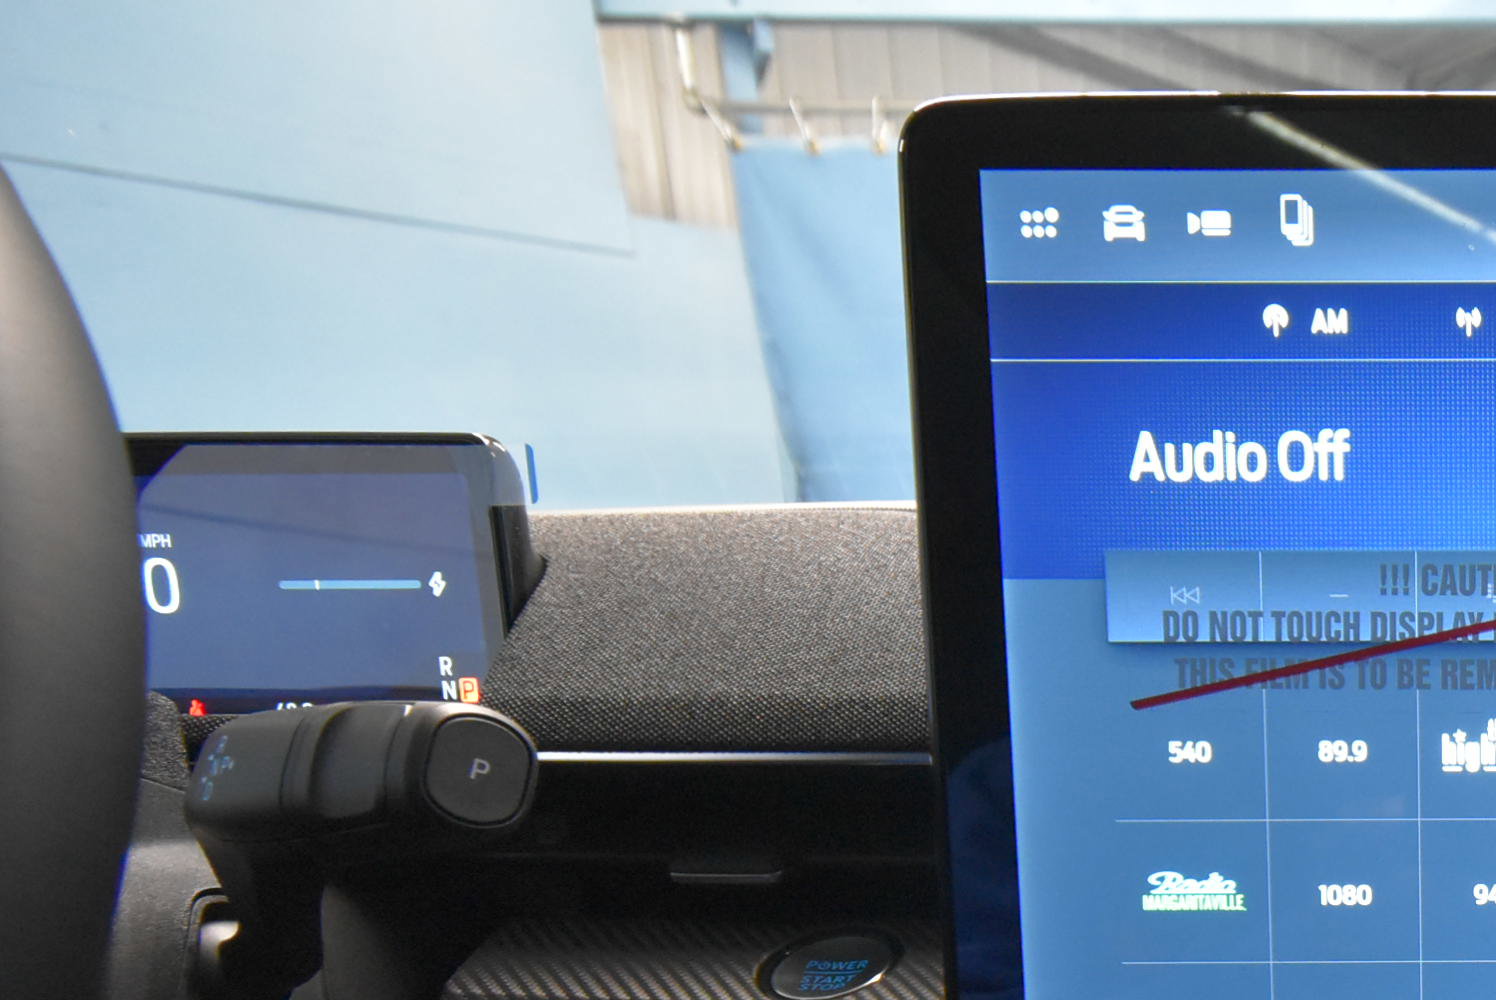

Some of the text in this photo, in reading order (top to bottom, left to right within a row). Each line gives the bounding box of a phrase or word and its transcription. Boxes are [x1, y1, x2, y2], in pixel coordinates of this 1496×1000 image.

[1310, 307, 1349, 335] AM
[1129, 428, 1351, 483] Audio Off
[143, 557, 180, 614] 0
[1379, 564, 1410, 595] !!!
[1163, 610, 1199, 643] DO
[1209, 610, 1263, 643] NOT
[1270, 611, 1361, 643] TOUCH
[1370, 611, 1484, 644] DISPLAY
[438, 656, 453, 677] R
[1174, 657, 1236, 689] THIS
[1245, 657, 1309, 690] FILM
[1318, 658, 1346, 690] IS
[1357, 657, 1387, 690] TO
[1397, 658, 1431, 690] BE
[442, 680, 457, 700] N
[463, 680, 476, 698] P
[1168, 741, 1213, 763] 540
[1317, 740, 1368, 762] 89.9
[470, 758, 491, 780] P
[1318, 884, 1372, 906] 1080
[806, 960, 870, 970] POWER
[801, 975, 857, 985] START
